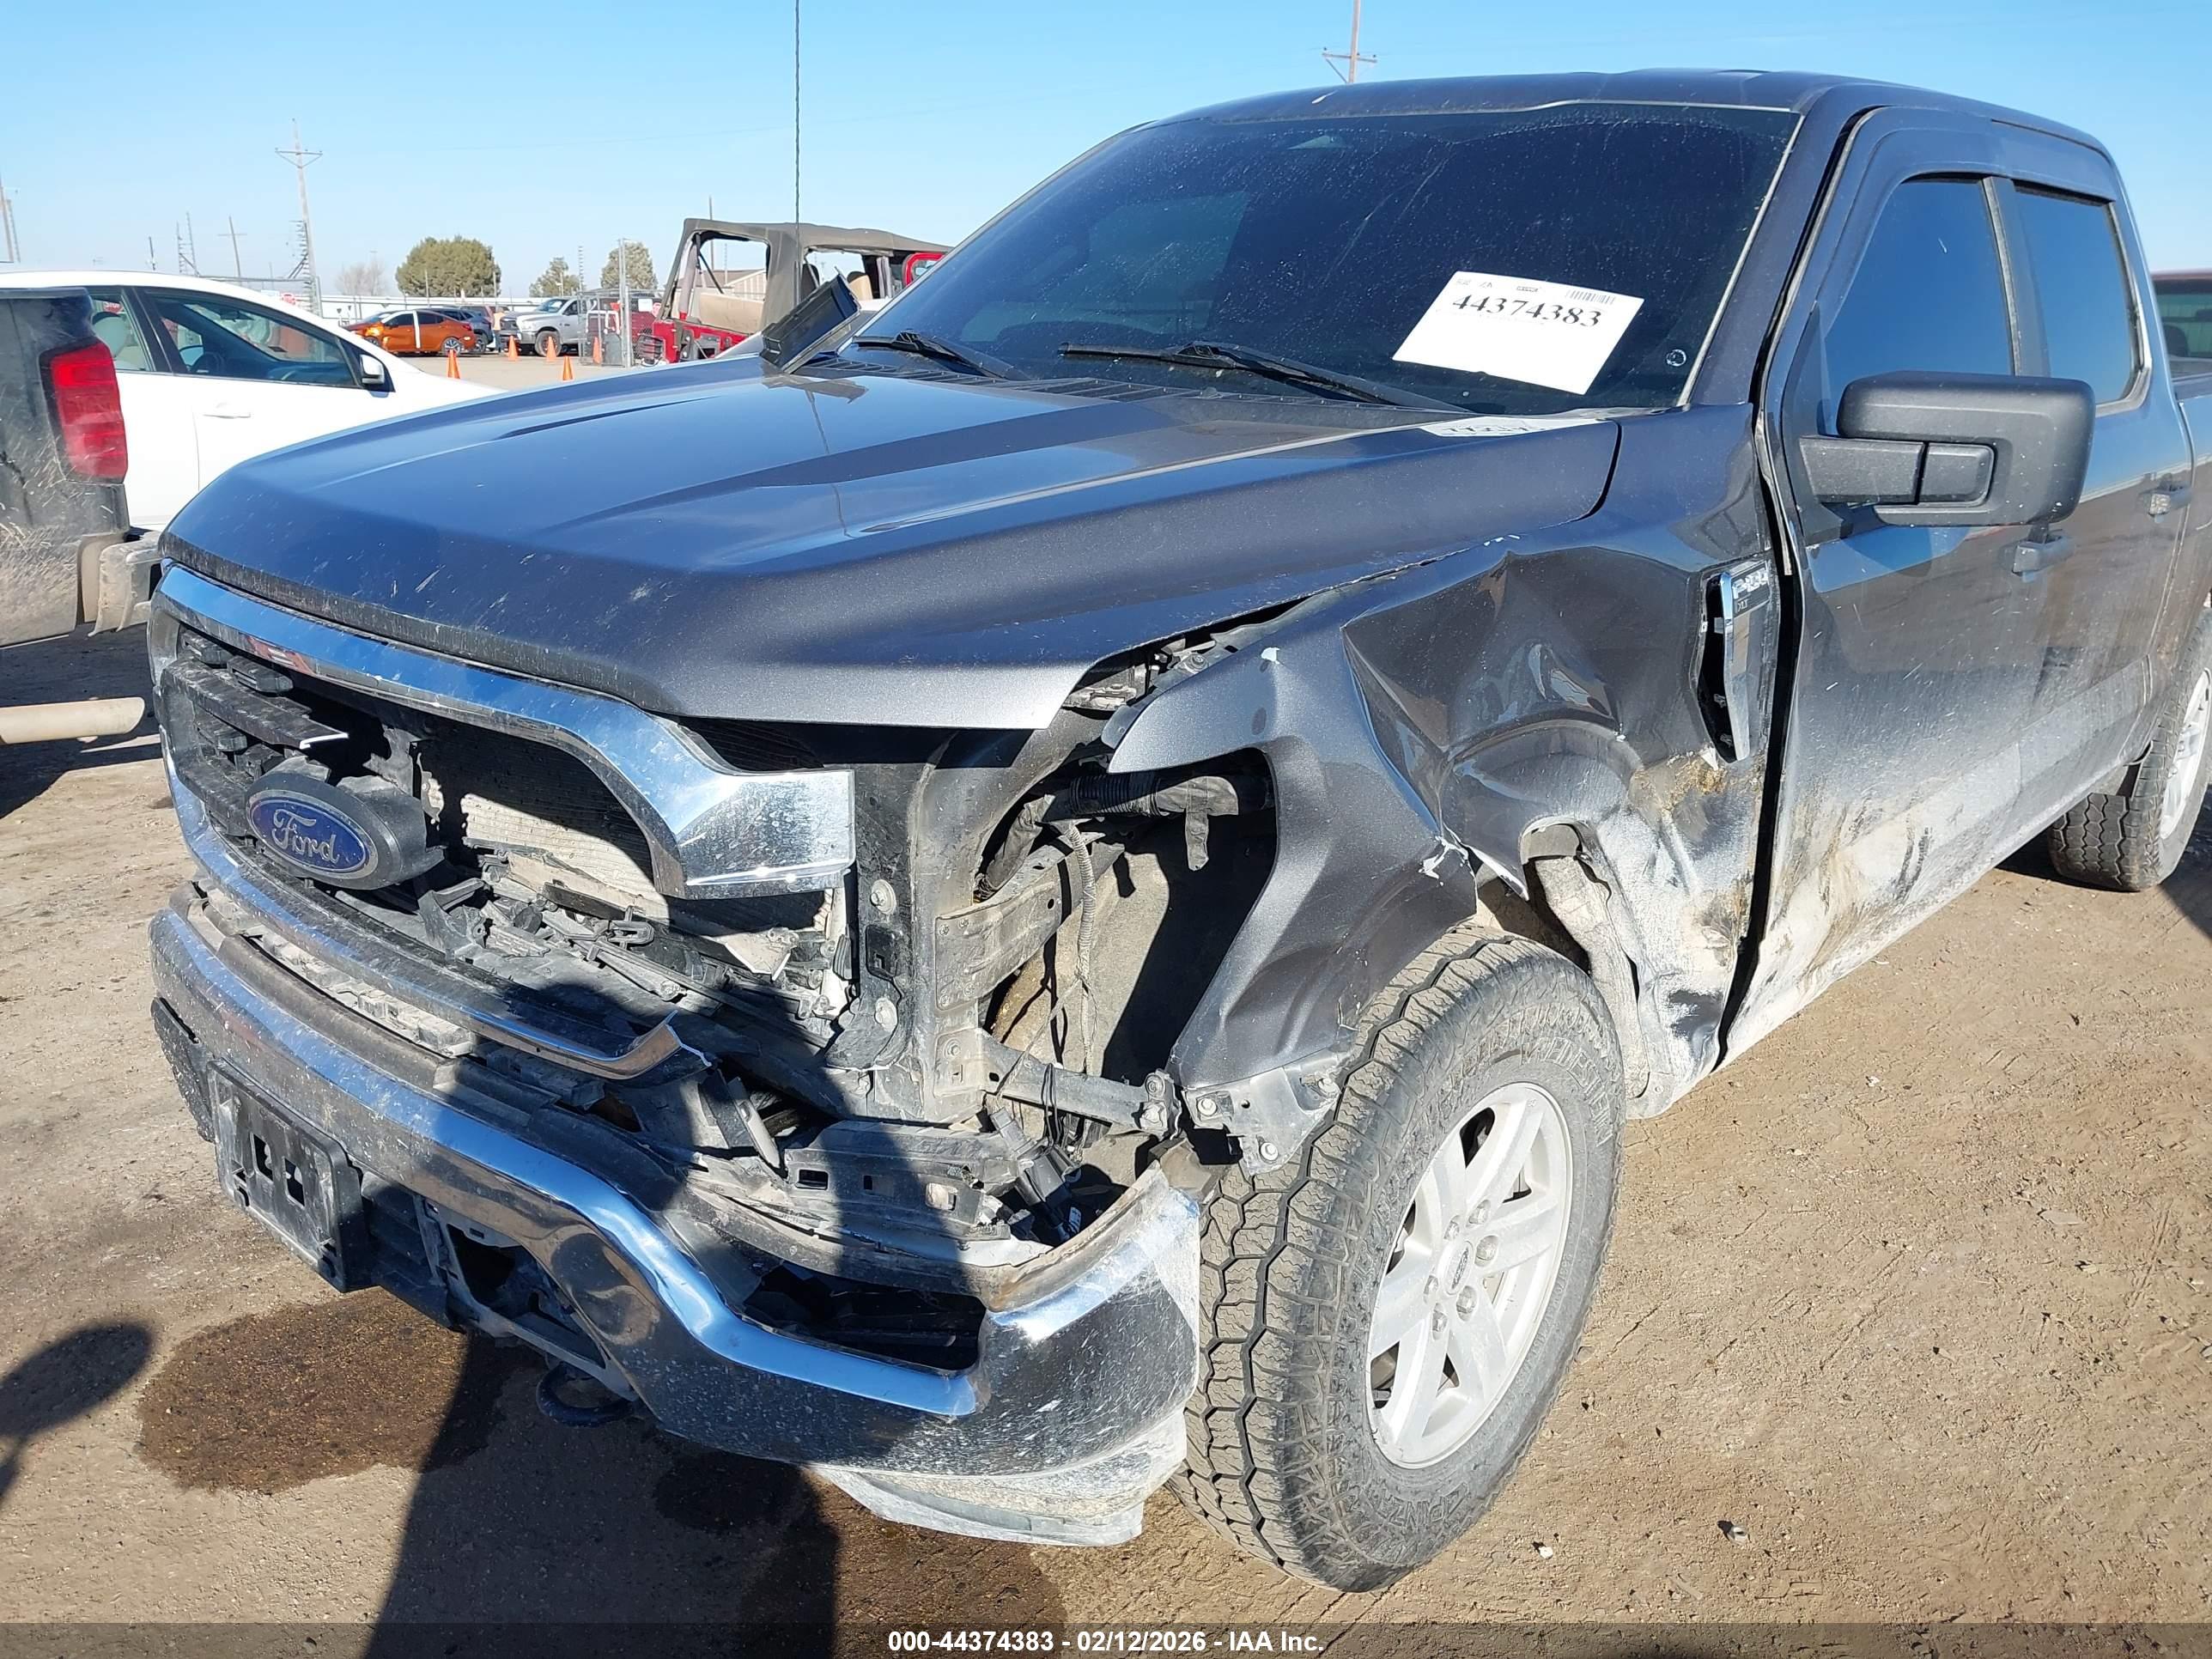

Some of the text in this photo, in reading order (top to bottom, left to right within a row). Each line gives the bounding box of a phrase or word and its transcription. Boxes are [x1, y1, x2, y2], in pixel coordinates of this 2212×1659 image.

[1452, 294, 1601, 327] 44374383
[1737, 599, 1748, 612] XLT
[271, 808, 340, 865] Ford
